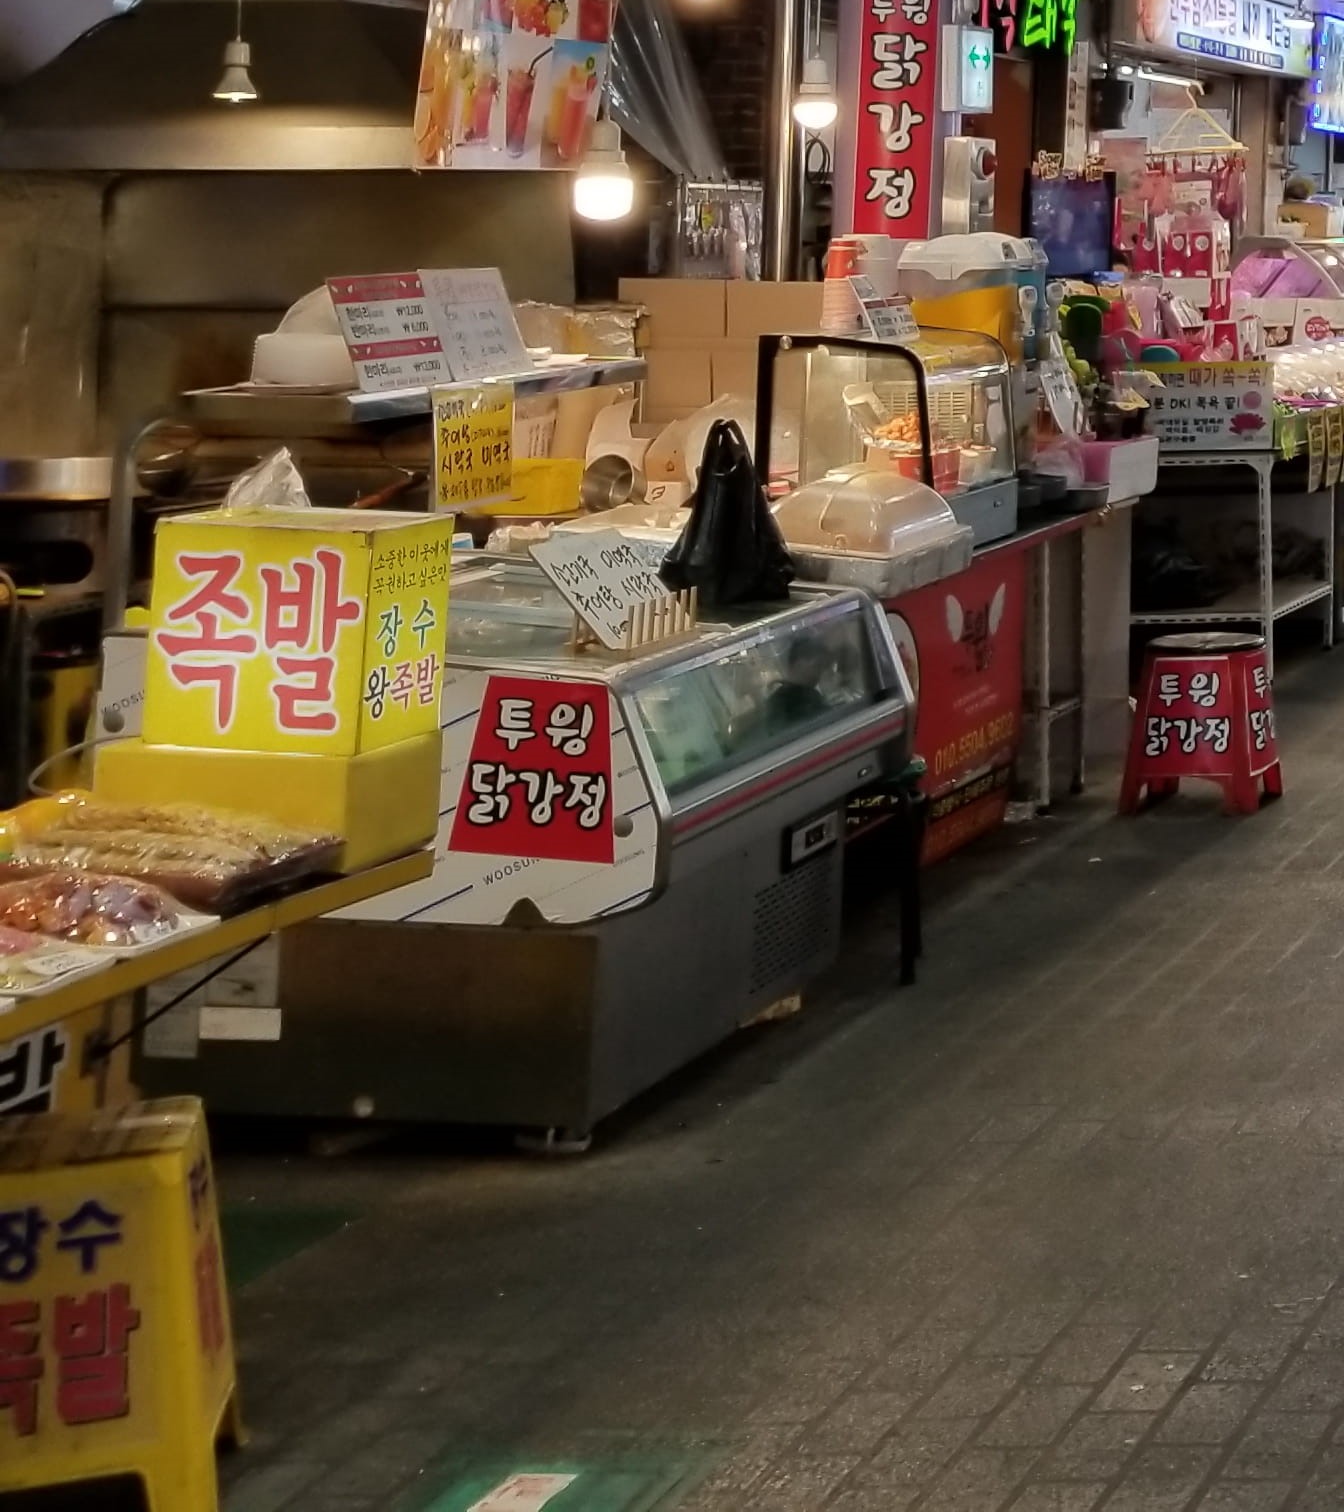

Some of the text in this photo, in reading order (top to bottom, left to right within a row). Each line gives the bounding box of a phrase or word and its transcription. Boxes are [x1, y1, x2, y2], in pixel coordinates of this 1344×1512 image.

[865, 34, 928, 219] 닭강정
[374, 538, 450, 572] 소중한 이웃에게
[157, 549, 361, 730] 족발
[376, 599, 436, 658] 장수
[364, 653, 441, 720] 왕족발
[1145, 716, 1230, 757] 닭강정
[467, 762, 607, 828] 닭강정
